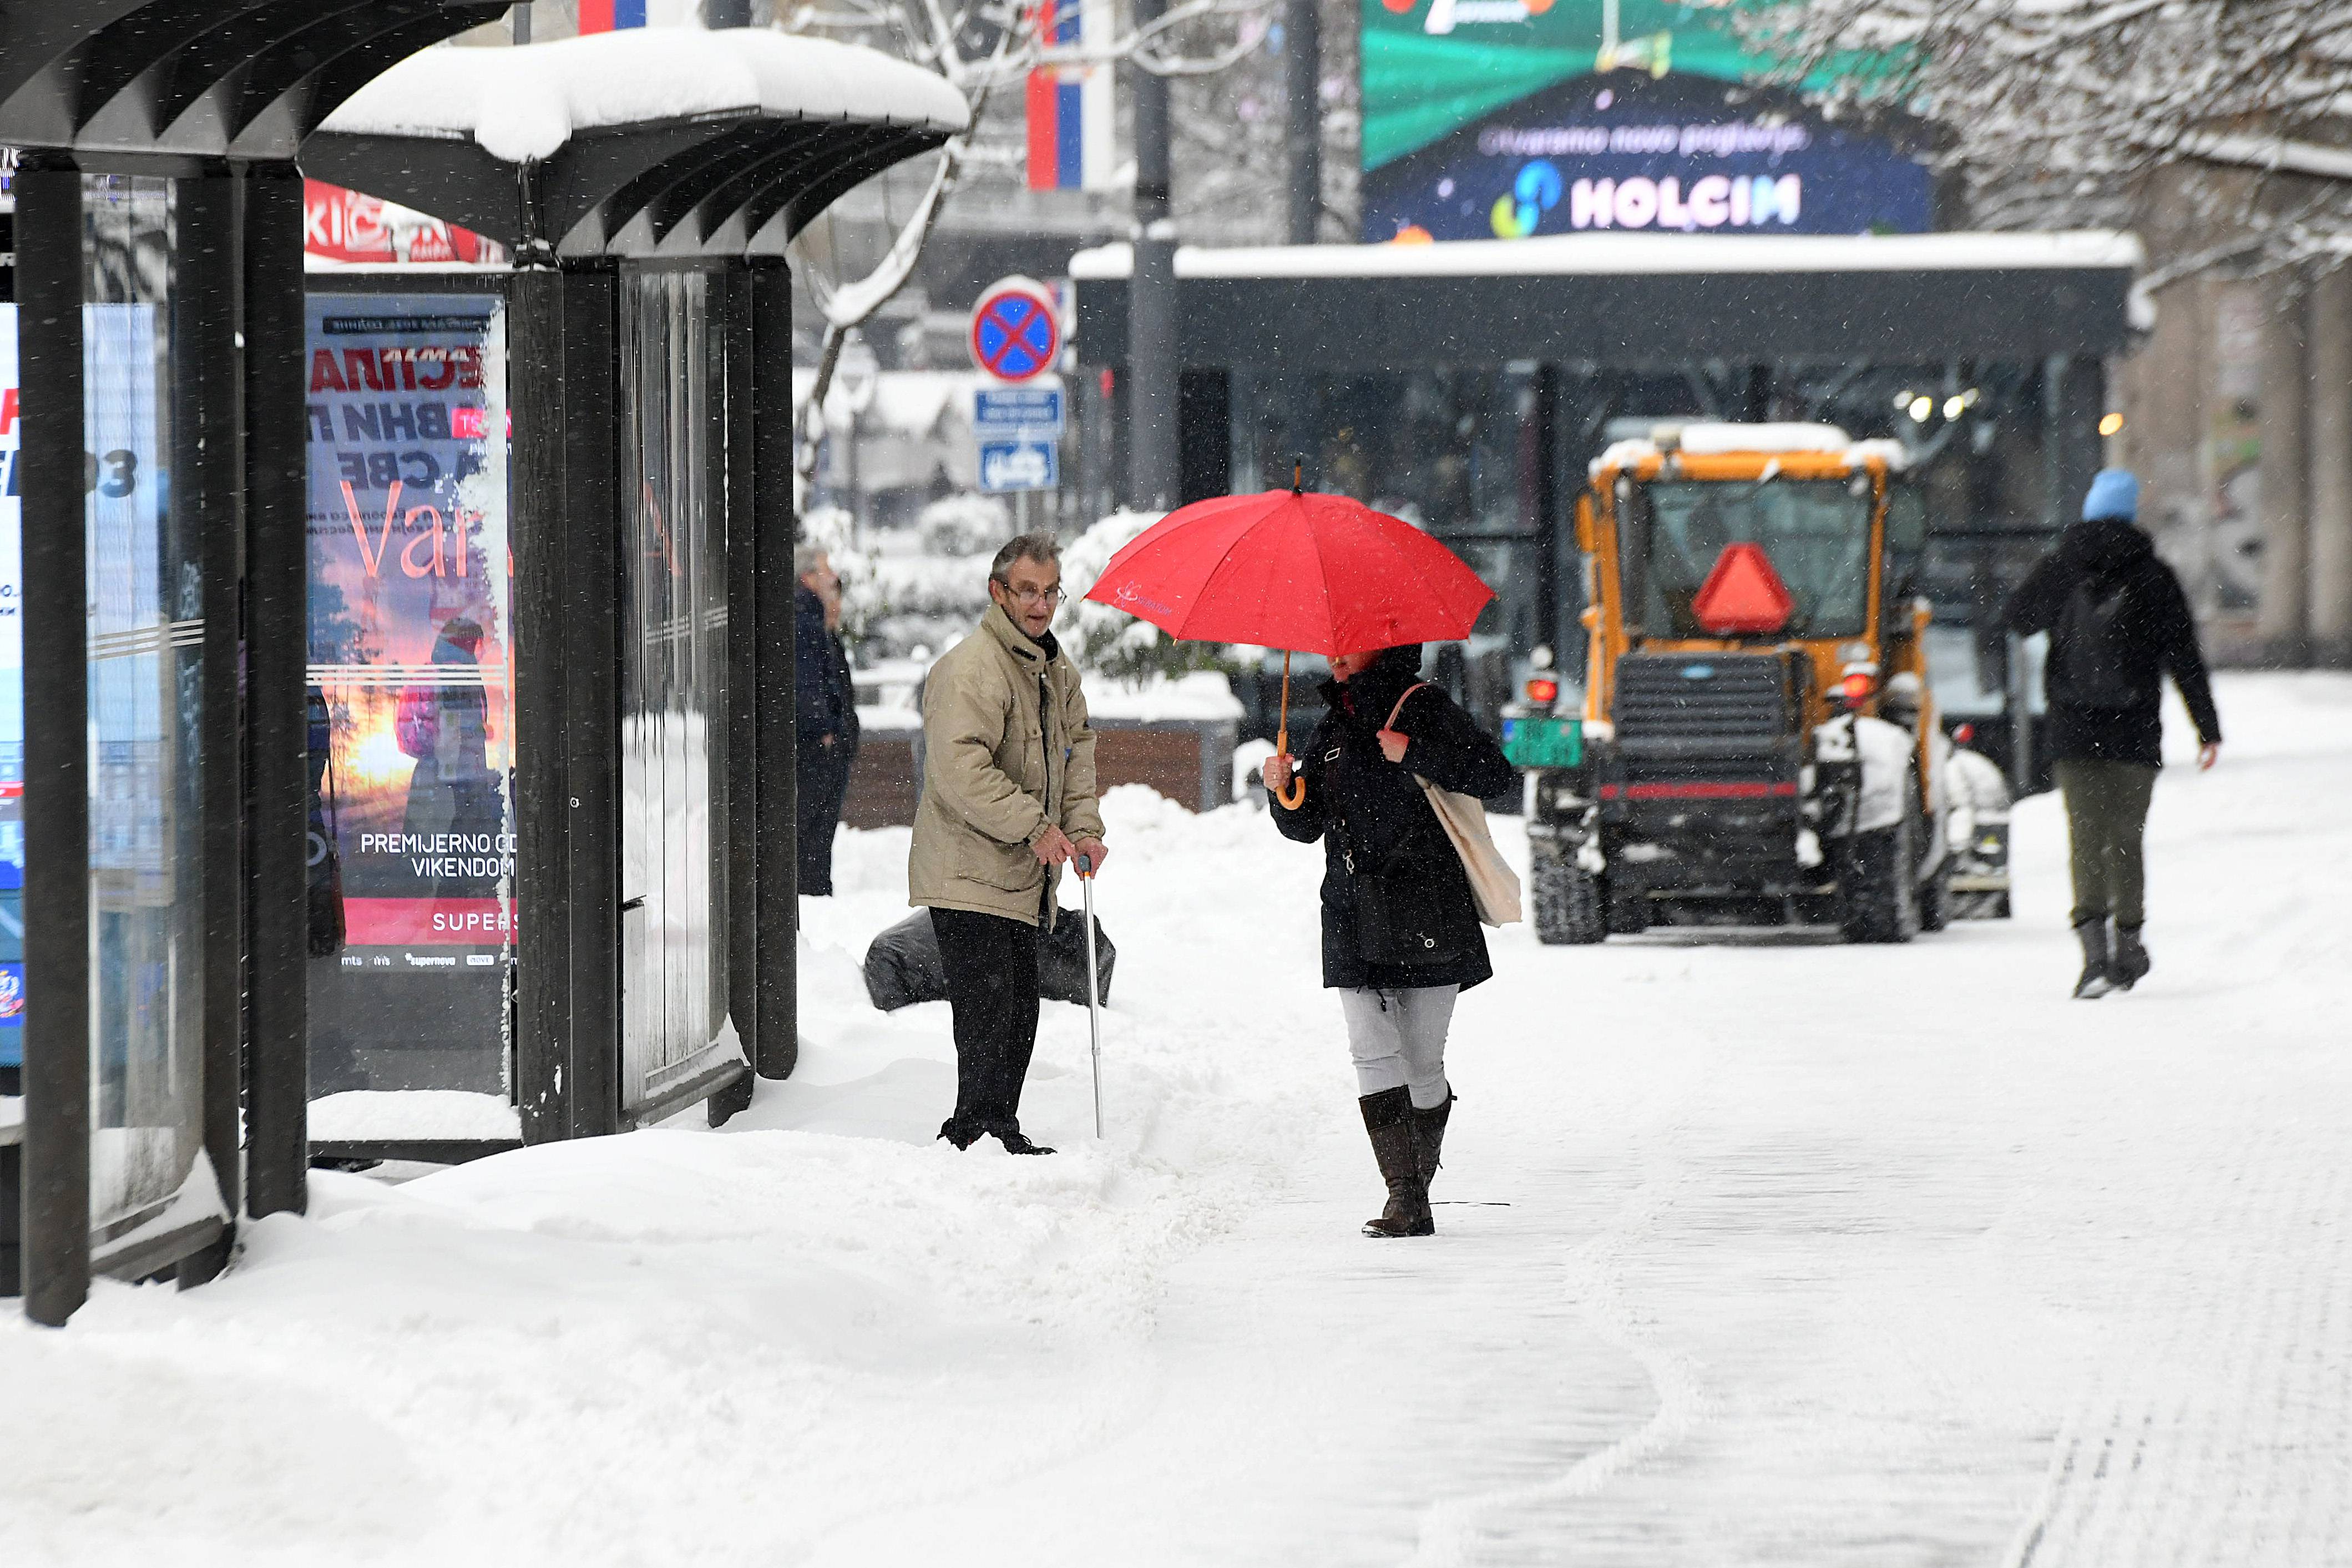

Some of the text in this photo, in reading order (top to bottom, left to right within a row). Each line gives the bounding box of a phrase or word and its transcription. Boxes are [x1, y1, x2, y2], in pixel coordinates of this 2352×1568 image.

[1571, 174, 1802, 228] HOLCIM
[361, 833, 490, 853] PREMIJERNO
[411, 857, 514, 877] VIKENDOM
[409, 955, 456, 968] supernova
